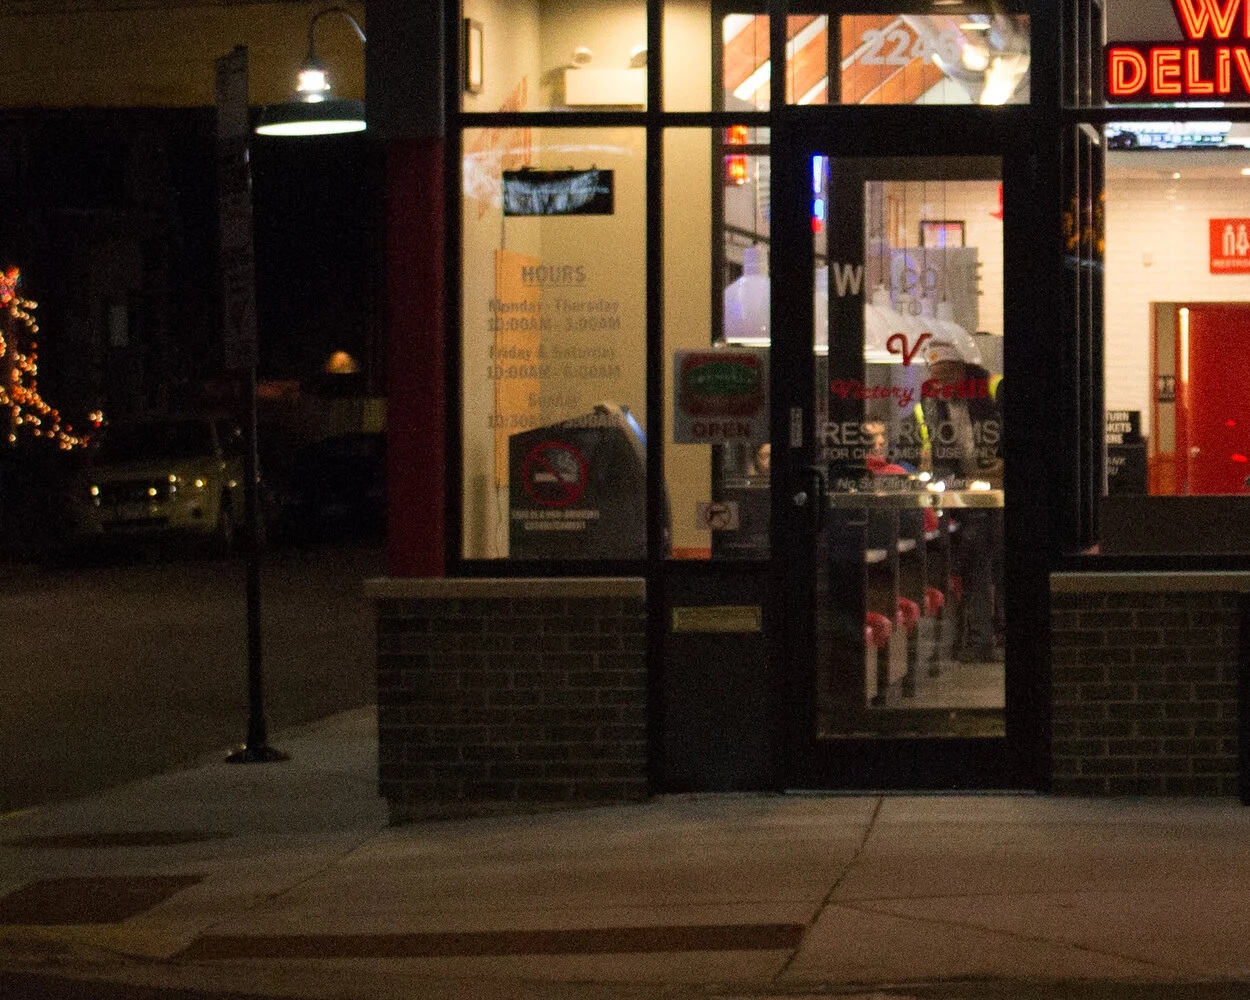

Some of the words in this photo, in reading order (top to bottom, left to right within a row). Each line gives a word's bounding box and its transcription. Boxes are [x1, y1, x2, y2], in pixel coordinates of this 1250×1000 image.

[860, 29, 962, 66] 2246
[521, 265, 587, 283] HOURS
[886, 332, 933, 367] V
[831, 379, 914, 408] Victory
[921, 378, 989, 399] Grill
